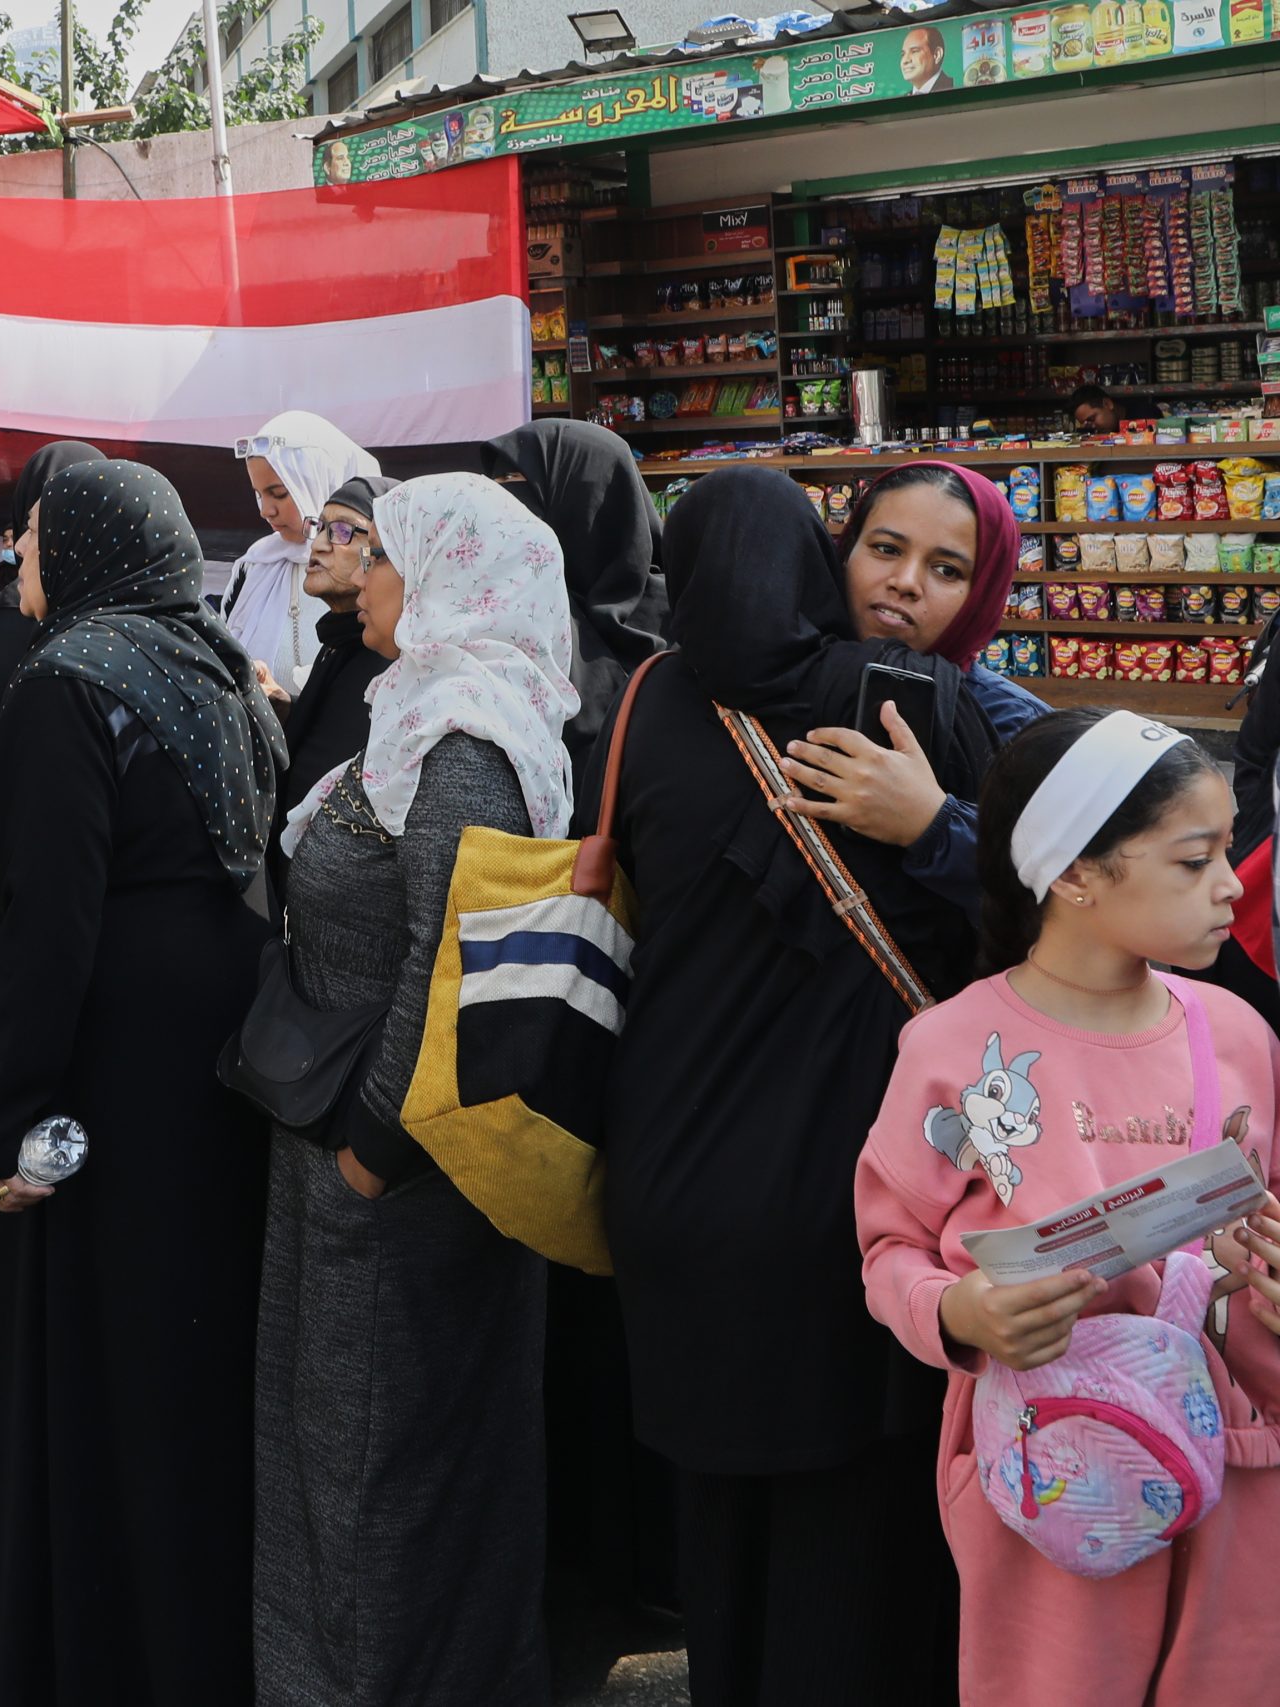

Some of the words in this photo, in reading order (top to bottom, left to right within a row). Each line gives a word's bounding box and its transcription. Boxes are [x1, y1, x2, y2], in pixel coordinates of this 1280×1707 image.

[794, 53, 833, 70] مصر
[835, 42, 873, 62] تحيا
[794, 72, 833, 90] مصر
[835, 62, 873, 82] تحيا
[795, 91, 834, 110] مصر
[836, 83, 874, 102] تحيا
[499, 74, 679, 135] المحروسة
[387, 127, 416, 145] تحيا
[507, 134, 563, 150] بالعجوزة
[359, 138, 387, 155] مصر
[388, 143, 417, 162] تحيا
[360, 154, 388, 172] مصر
[390, 159, 419, 178] تحيا
[1108, 1187, 1145, 1210] البرنامج
[1051, 1208, 1093, 1233] الانتخابي
